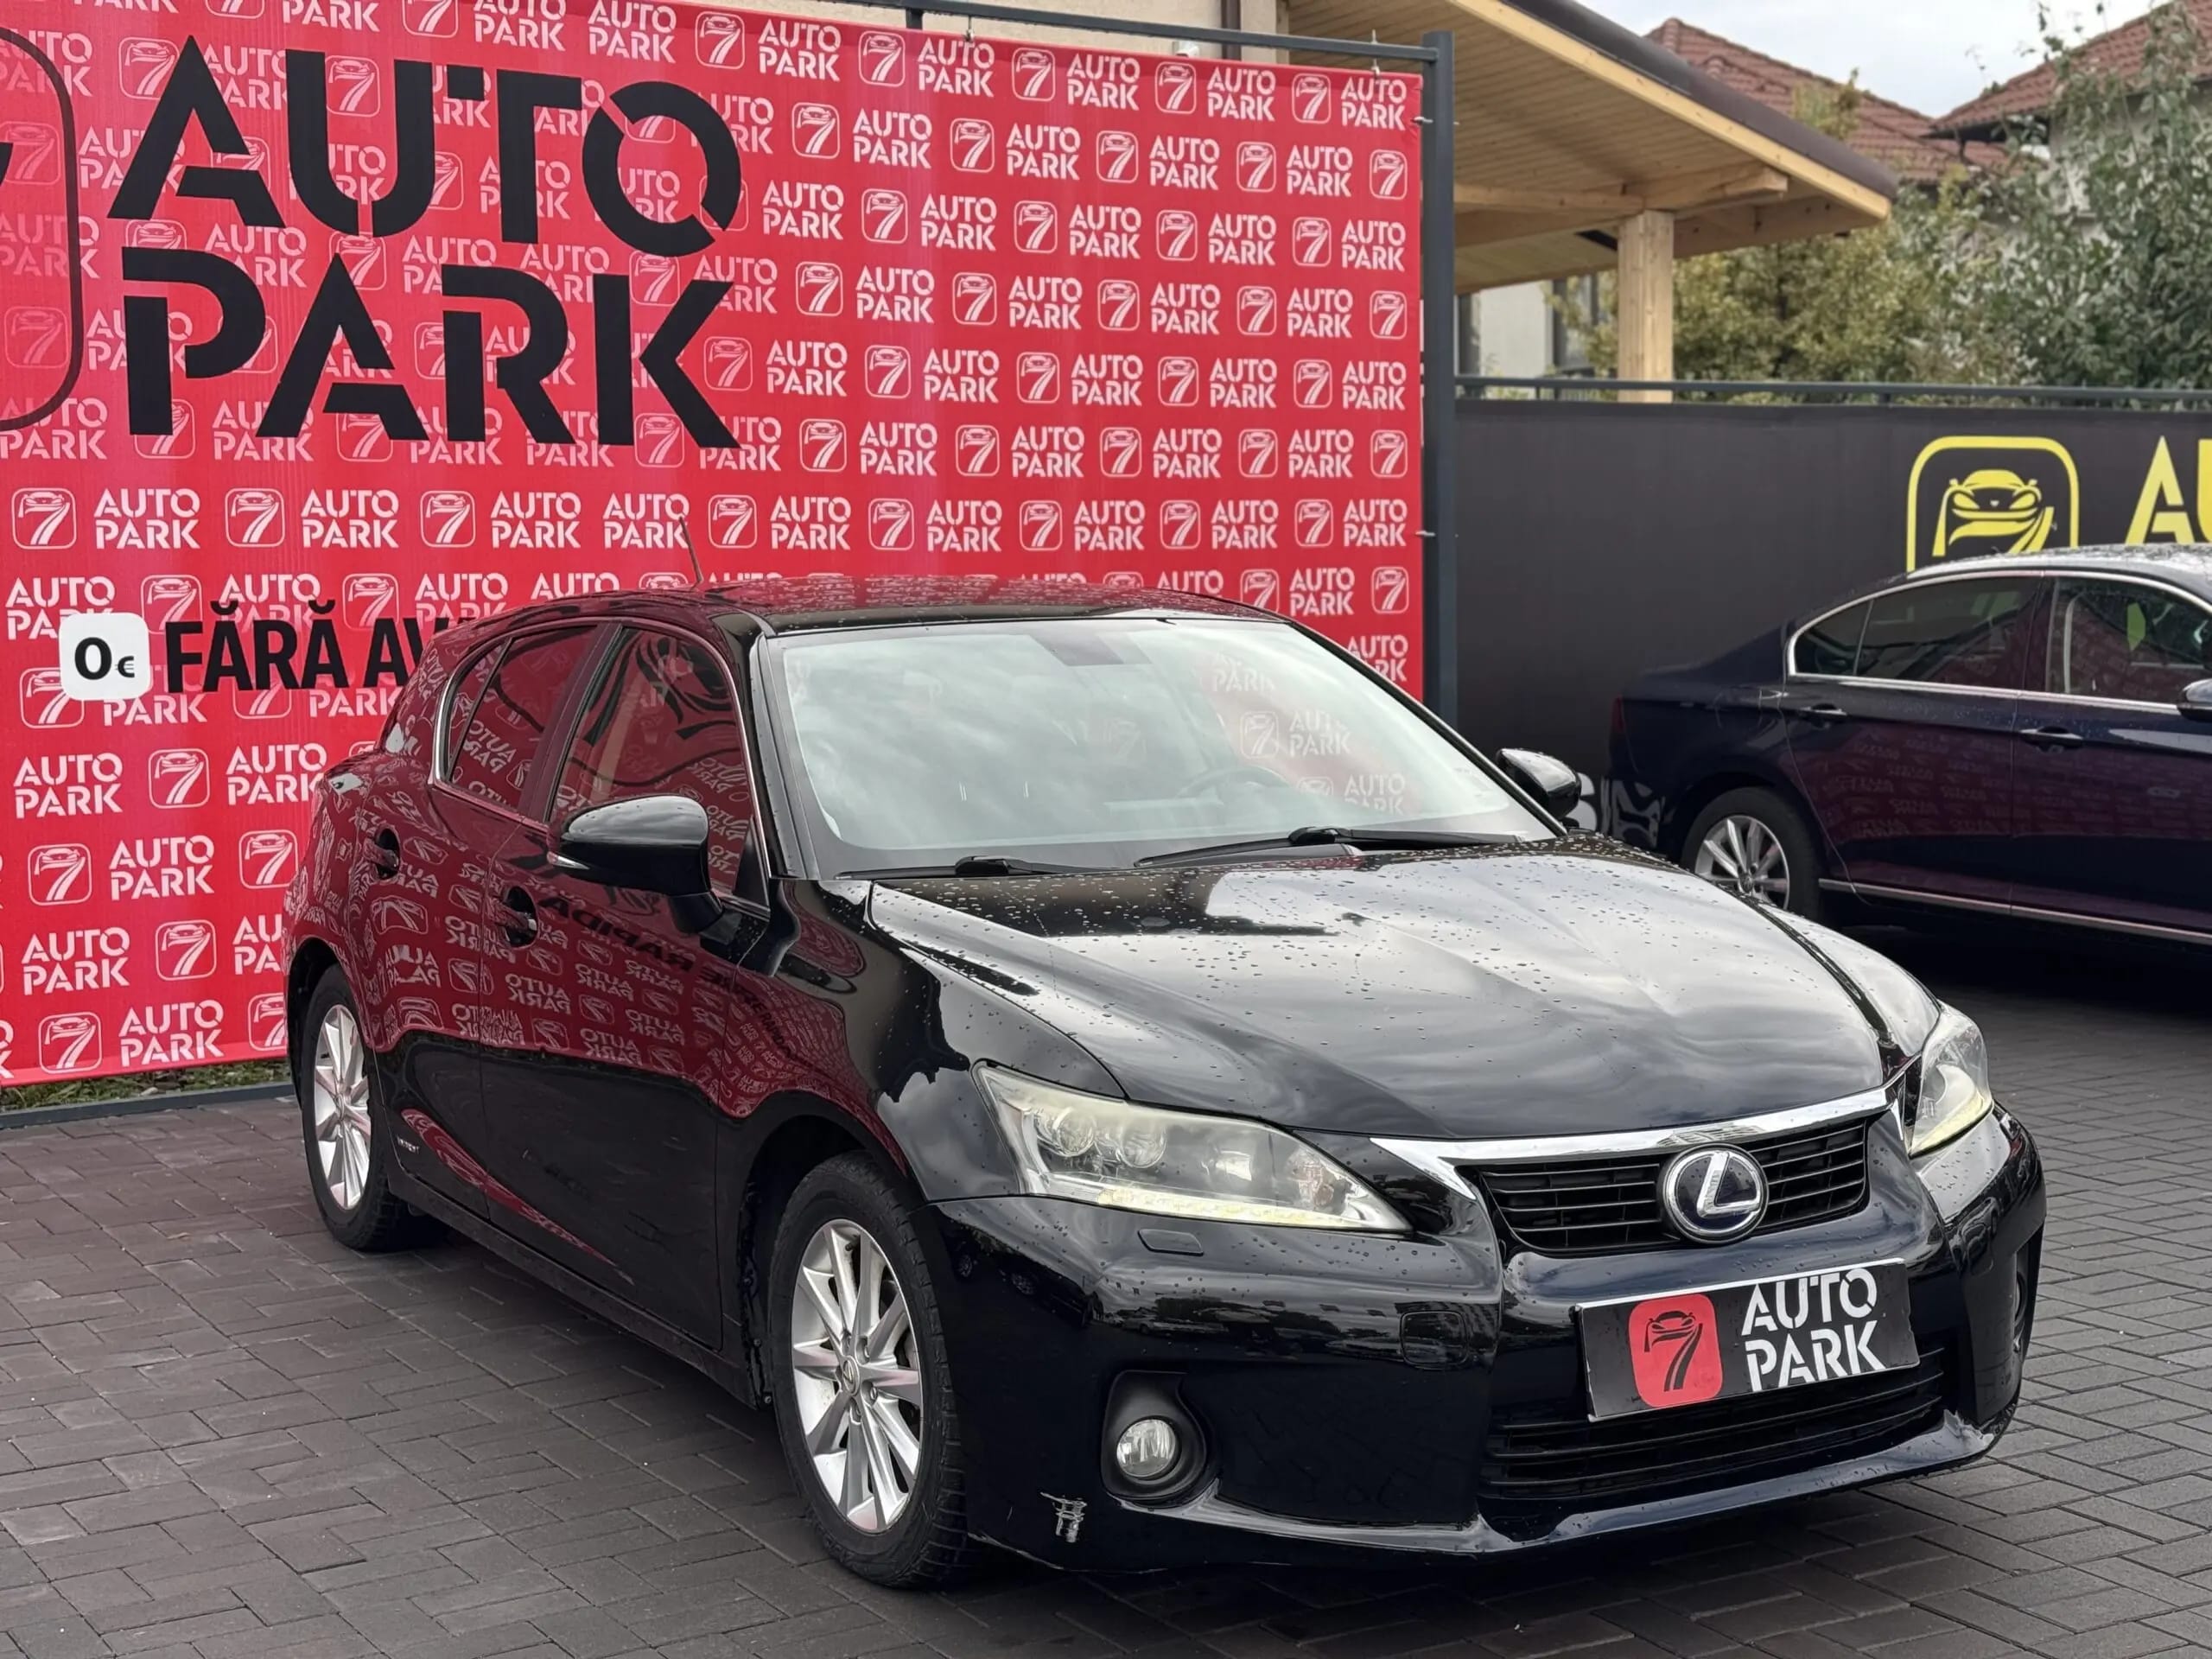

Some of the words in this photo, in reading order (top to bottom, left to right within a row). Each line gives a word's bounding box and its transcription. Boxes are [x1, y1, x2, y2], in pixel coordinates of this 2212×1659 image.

[282, 0, 380, 33] PARK
[588, 0, 677, 34] AUTO
[474, 14, 565, 52] PARK
[589, 26, 676, 63] PARK
[758, 19, 841, 53] AUTO
[759, 46, 840, 81] PARK
[918, 38, 995, 69] AUTO
[919, 64, 993, 97] PARK
[1067, 54, 1140, 83] AUTO
[1207, 67, 1275, 95] AUTO
[216, 79, 286, 110] ARK
[1068, 79, 1139, 111] PARK
[1341, 78, 1407, 104] AUTO
[710, 92, 774, 128] UTO
[1208, 92, 1274, 121] PARK
[1342, 101, 1405, 130] PARK
[853, 108, 932, 141] AUTO
[107, 35, 741, 257] AUTO
[854, 136, 931, 169] PARK
[1006, 124, 1080, 154] AUTO
[1149, 136, 1220, 164] AUTO
[1007, 149, 1079, 180] PARK
[1287, 145, 1353, 171] AUTO
[1150, 160, 1218, 190] PARK
[1287, 169, 1351, 197] PARK
[762, 180, 844, 212] AUTO
[920, 194, 997, 224] AUTO
[763, 207, 843, 240] PARK
[1070, 205, 1141, 232] AUTO
[1208, 213, 1276, 240] AUTO
[204, 222, 308, 257] AUTO
[921, 220, 995, 251] PARK
[1070, 230, 1140, 258] PARK
[1342, 220, 1406, 246] AUTO
[402, 234, 497, 266] AUTO
[519, 243, 609, 273] AUTO
[1209, 238, 1275, 265] PARK
[1342, 244, 1404, 271] PARK
[694, 254, 777, 285] AUTO
[855, 265, 935, 296] AUTO
[1008, 276, 1083, 303] AUTO
[1151, 283, 1221, 309] AUTO
[1287, 288, 1353, 313] AUTO
[857, 293, 934, 323] PARK
[1009, 302, 1081, 329] PARK
[1152, 308, 1219, 334] PARK
[1287, 312, 1351, 338] PARK
[122, 246, 741, 448] PARK
[766, 340, 848, 369] AUTO
[923, 348, 1000, 376] AUTO
[1071, 354, 1143, 380] AUTO
[1210, 359, 1277, 384] AUTO
[1342, 361, 1407, 386] AUTO
[767, 367, 847, 397] PARK
[925, 375, 998, 403] PARK
[1072, 379, 1141, 406] PARK
[1211, 383, 1276, 408] PARK
[1343, 385, 1405, 410] PARK
[0, 429, 107, 460] PARK
[213, 431, 314, 462] PARK
[859, 422, 938, 449] AUTO
[1011, 426, 1084, 452] AUTO
[1153, 429, 1222, 453] AUTO
[1288, 429, 1353, 453] AUTO
[410, 438, 503, 467] PARK
[525, 442, 613, 467] PARK
[700, 444, 782, 471] PARK
[861, 448, 937, 476] PARK
[1013, 452, 1084, 477] PARK
[1154, 453, 1221, 479] PARK
[1289, 454, 1352, 477] PARK
[94, 488, 200, 518] AUTO
[301, 489, 399, 518] AUTO
[491, 491, 581, 519] AUTO
[603, 493, 690, 521] AUTO
[770, 496, 851, 523] AUTO
[926, 500, 1002, 525] AUTO
[1074, 500, 1145, 524] AUTO
[1211, 499, 1279, 524] AUTO
[1344, 499, 1408, 523] AUTO
[96, 518, 200, 549] PARK
[302, 518, 398, 548] PARK
[492, 520, 581, 548] PARK
[604, 521, 689, 549] PARK
[772, 523, 850, 550] PARK
[927, 526, 1001, 552] PARK
[1075, 525, 1144, 551] PARK
[1212, 524, 1277, 549] PARK
[1344, 523, 1406, 546] PARK
[7, 576, 115, 609] AUTO
[221, 573, 321, 604] AUTO
[415, 573, 508, 601] AUTO
[1157, 571, 1224, 594] AUTO
[1290, 568, 1355, 591] AUTO
[1290, 592, 1353, 617] PARK
[165, 600, 346, 693] FĂRĂ
[1347, 634, 1408, 658] AUTO
[103, 694, 207, 726] PARK
[14, 753, 123, 786] AUTO
[226, 742, 327, 776] AUTO
[1344, 773, 1405, 796] AUTO
[15, 783, 123, 818] PARK
[109, 835, 214, 869] AUTO
[111, 865, 214, 900] PARK
[22, 927, 130, 963] AUTO
[23, 957, 130, 995] PARK
[119, 1000, 223, 1037] AUTO
[122, 1029, 224, 1067] PARK
[1741, 1268, 1877, 1337] AUTO
[1744, 1320, 1885, 1393] PARK
